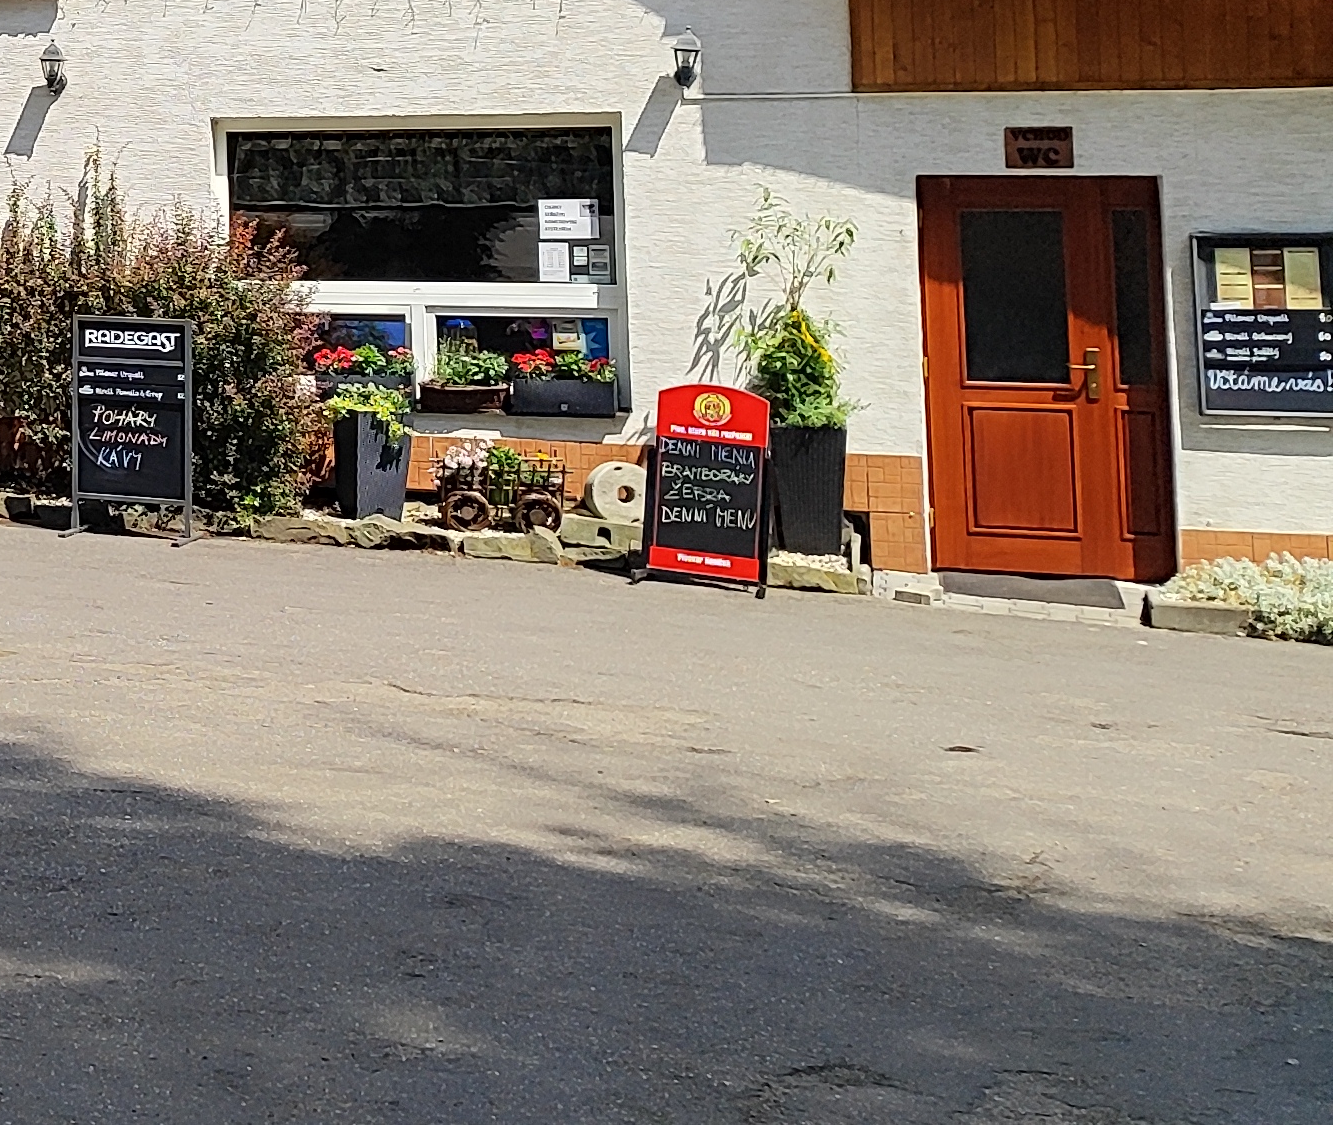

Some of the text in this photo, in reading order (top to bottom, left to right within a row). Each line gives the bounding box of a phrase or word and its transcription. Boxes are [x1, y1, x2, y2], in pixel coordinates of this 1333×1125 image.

[1016, 147, 1060, 165] WC
[84, 329, 181, 353] RADEGAST
[91, 404, 157, 428] POHÁRY
[96, 445, 142, 471] KÁVY
[661, 504, 757, 530] DENNÍ MENU
